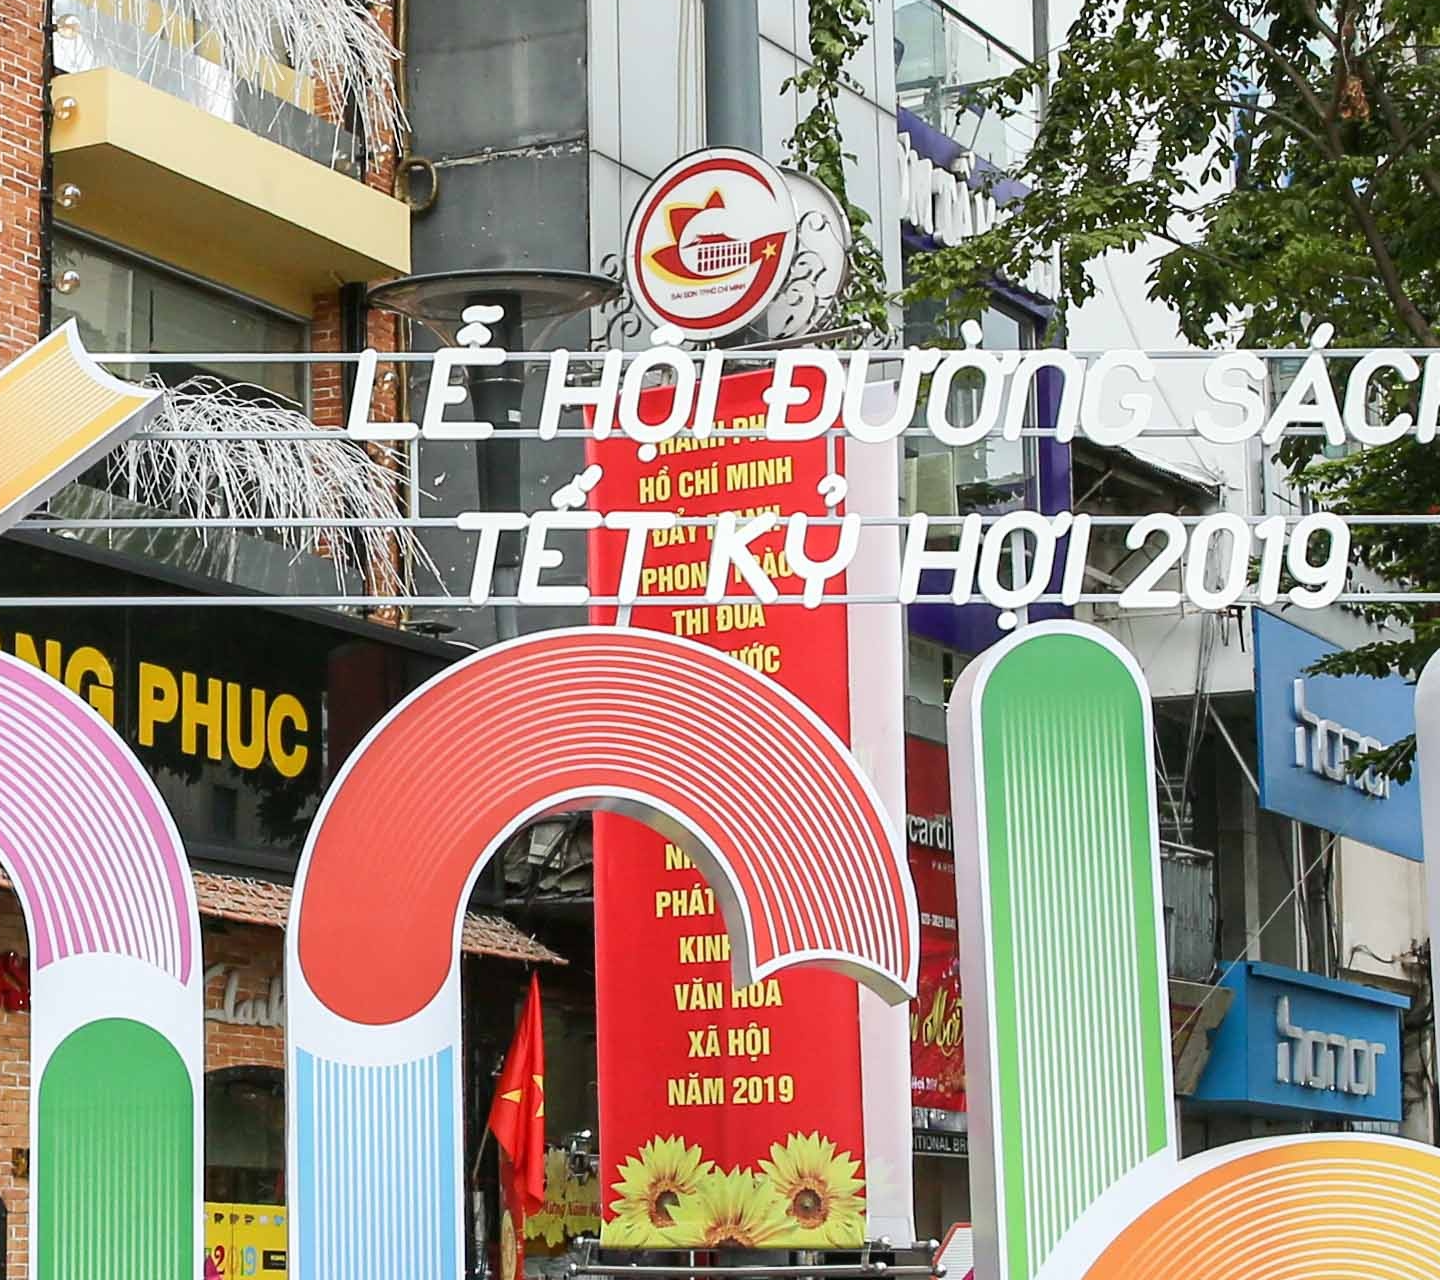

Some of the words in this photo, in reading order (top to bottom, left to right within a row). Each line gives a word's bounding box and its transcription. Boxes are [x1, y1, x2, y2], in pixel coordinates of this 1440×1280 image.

[347, 304, 507, 441] LỄ
[539, 325, 723, 462] HỘI
[763, 320, 1155, 446] ĐƯỜNG
[639, 466, 671, 503] HỒ
[679, 462, 718, 494] CHÍ
[726, 457, 792, 491] MINH
[457, 464, 675, 605] TẾT
[705, 473, 860, 608] KỶ
[899, 511, 1091, 630] HỢI
[1120, 511, 1350, 609] 2019
[642, 564, 710, 595] PHON
[672, 607, 709, 636] THI
[717, 603, 766, 632] ĐUA
[138, 662, 308, 778] PHUC
[908, 816, 952, 851] cardi
[674, 978, 723, 1010] VĂN
[688, 1025, 721, 1057] XÃ
[728, 1023, 770, 1061] HỘI
[1276, 995, 1386, 1097] honor
[668, 1073, 724, 1106] NĂM
[732, 1075, 795, 1105] 2019
